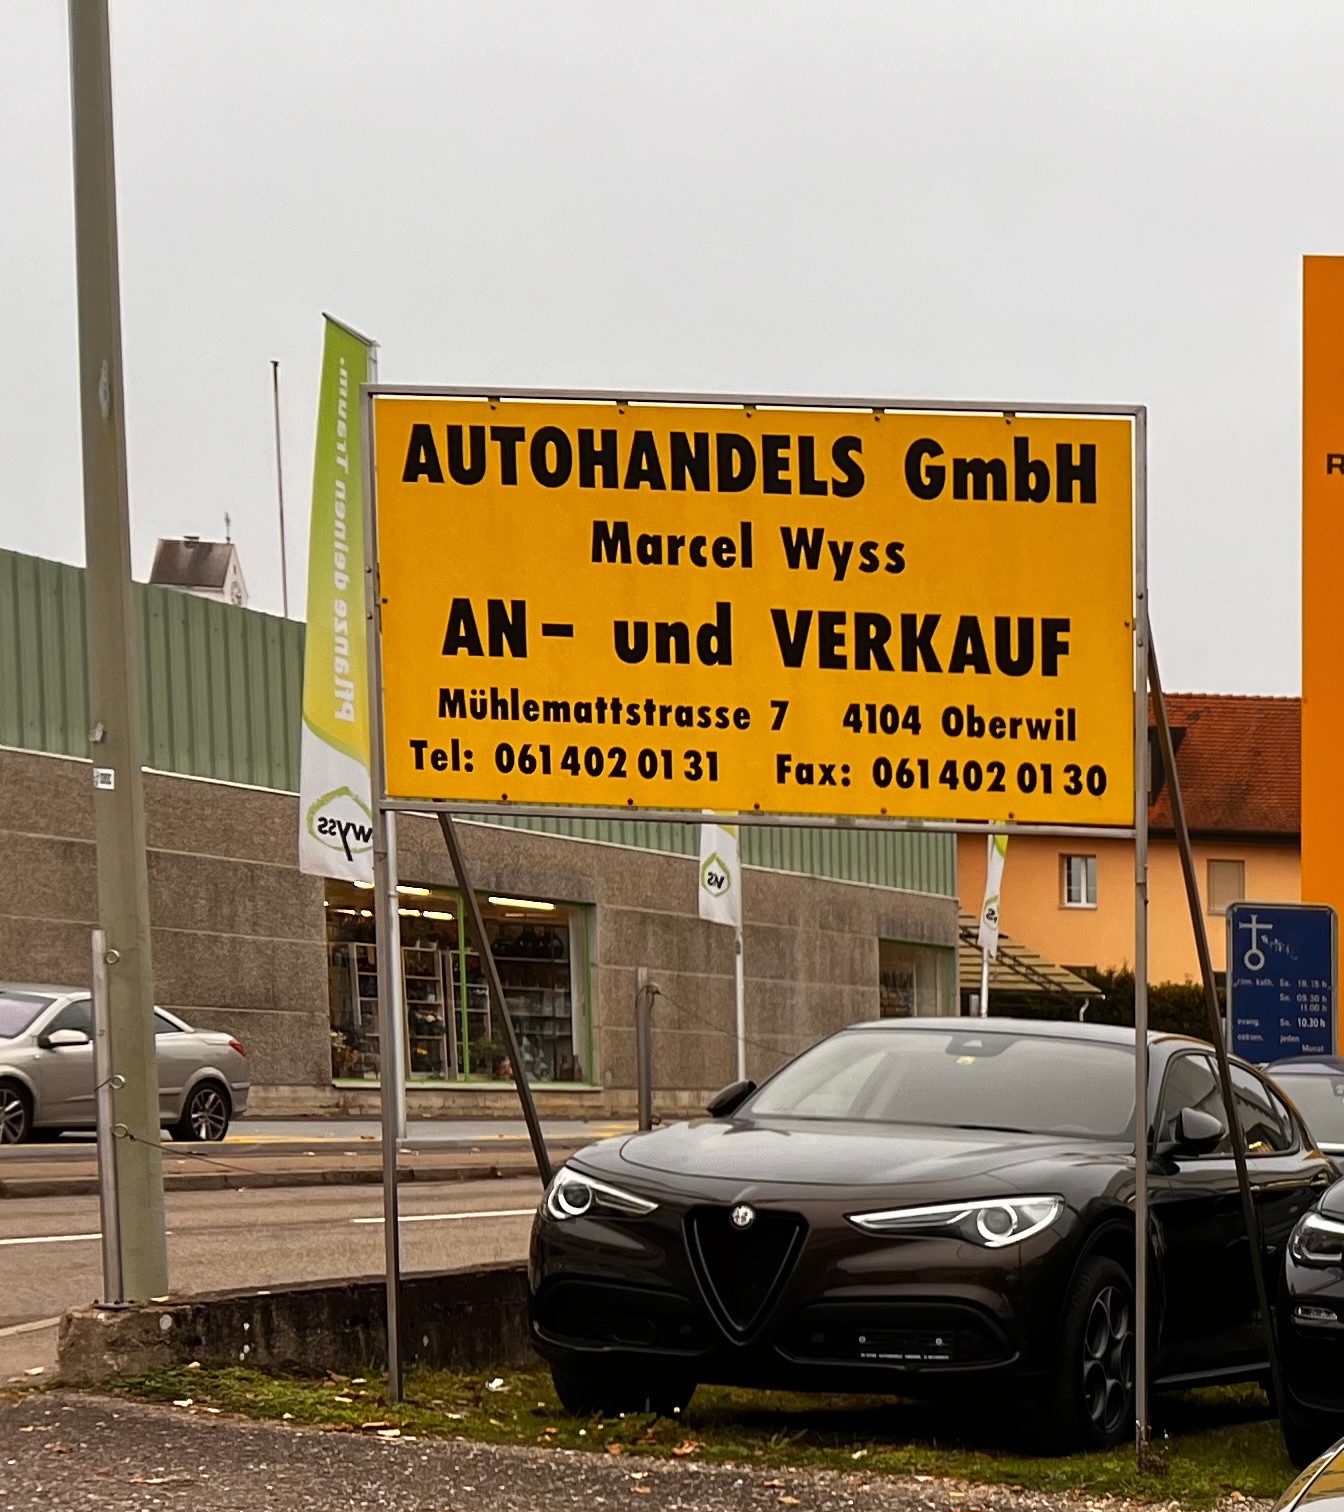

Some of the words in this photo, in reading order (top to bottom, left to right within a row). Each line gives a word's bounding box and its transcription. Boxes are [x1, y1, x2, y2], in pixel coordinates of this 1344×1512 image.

[402, 423, 865, 498] AUTOHANDELS
[904, 436, 1097, 505] GmbH
[591, 520, 753, 569] Marcel
[780, 526, 906, 582] Wyss
[613, 601, 733, 666] und
[770, 608, 1071, 677] VERKAUF
[438, 687, 751, 730] Mühlemattstrasse
[770, 700, 789, 731] 7
[842, 703, 922, 736] 4104
[941, 705, 1076, 742] Oberwil
[409, 738, 474, 773] Tel:
[776, 753, 851, 787] Fax:
